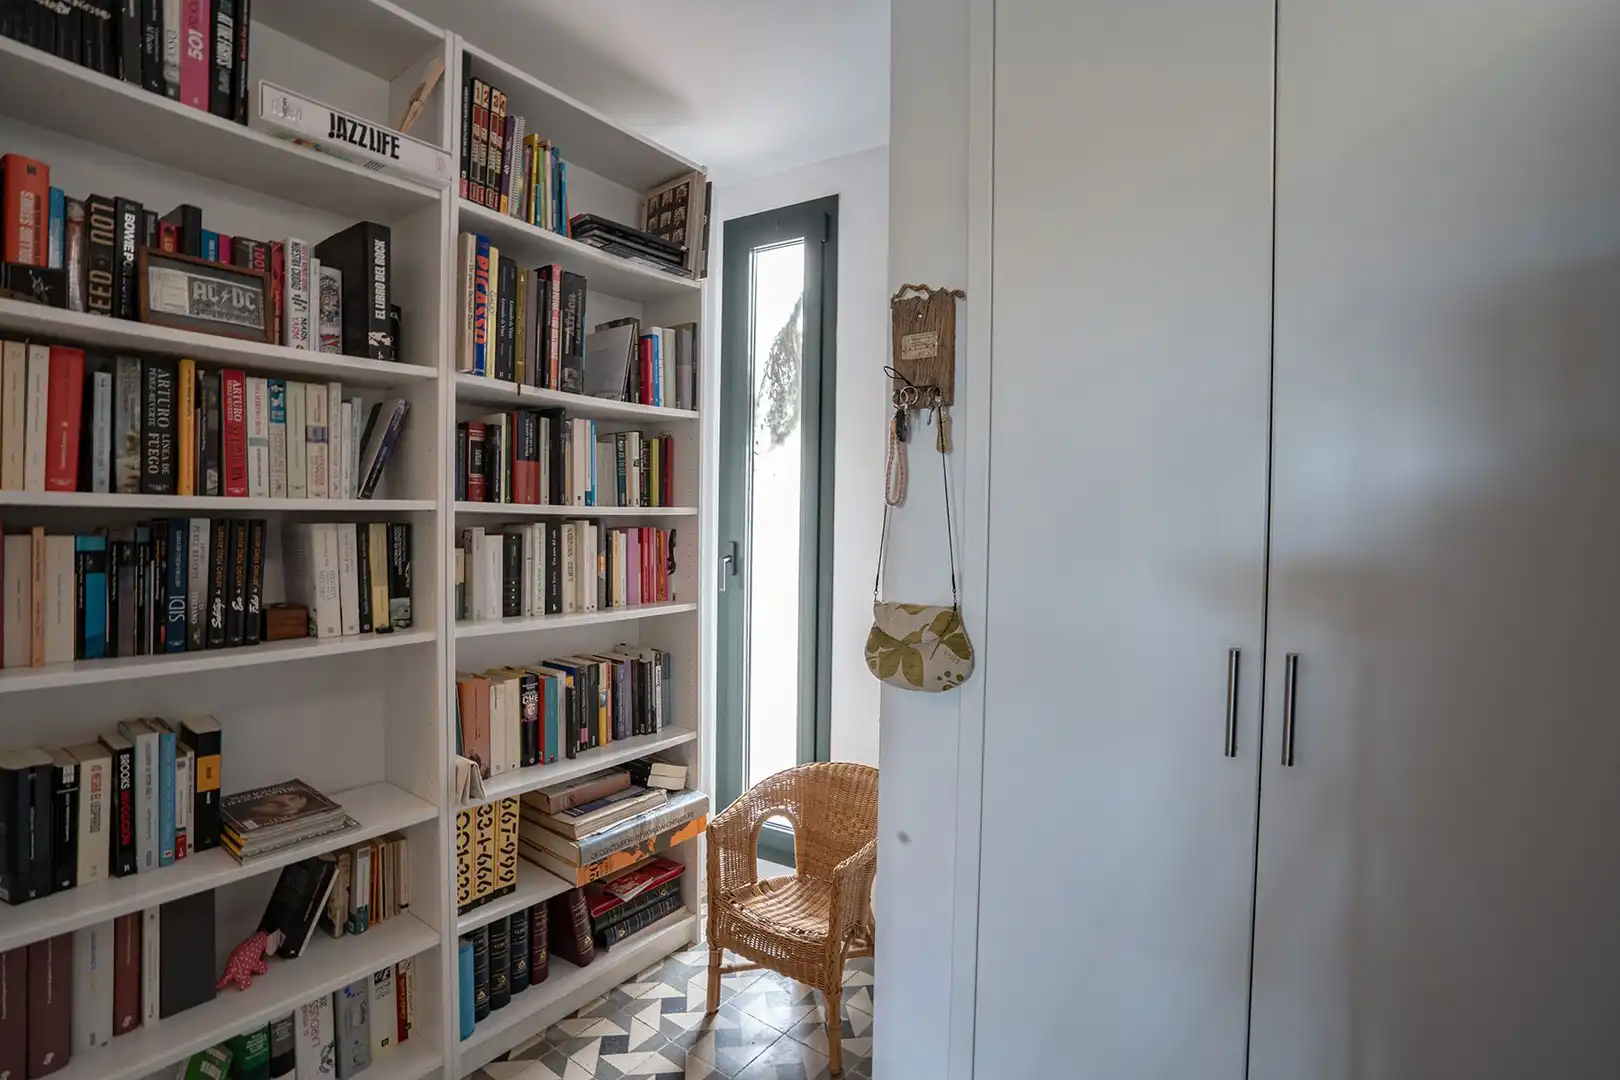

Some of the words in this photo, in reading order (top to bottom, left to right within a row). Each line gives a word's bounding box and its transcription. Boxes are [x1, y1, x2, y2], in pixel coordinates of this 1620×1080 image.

[87, 203, 114, 246] LOU
[122, 213, 136, 251] BOWIE
[372, 239, 386, 266] ROCK
[373, 266, 386, 286] DEL
[374, 286, 387, 309] LIBRO
[374, 309, 387, 320] EL
[475, 255, 488, 345] PICASSO
[147, 367, 157, 427] PÉREZ-REVERTE
[157, 368, 171, 428] ARTURO
[233, 380, 243, 422] ARTURO
[147, 432, 161, 475] FUEGO
[161, 462, 171, 475] DE
[168, 594, 185, 623] SIDI
[232, 595, 244, 611] Eva
[522, 694, 538, 705] CHE
[119, 754, 132, 790] BROOKS
[309, 1000, 321, 1048] LAROUSS
